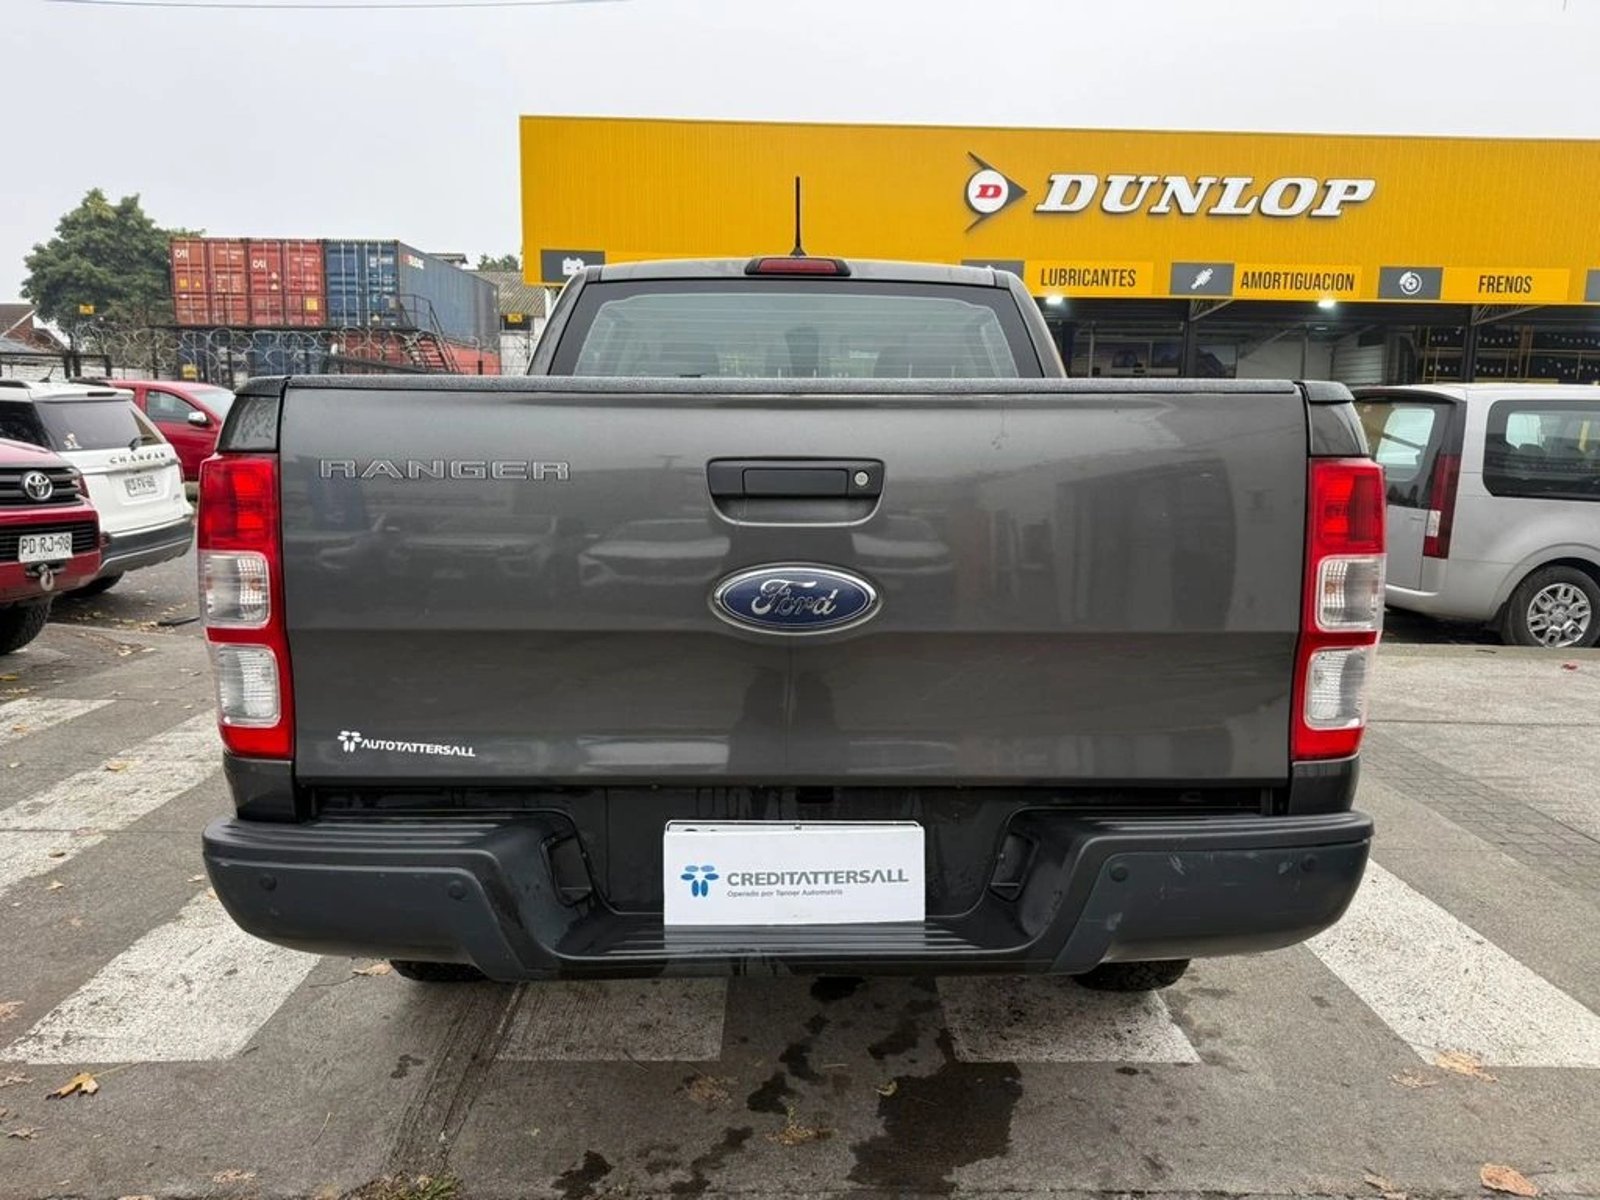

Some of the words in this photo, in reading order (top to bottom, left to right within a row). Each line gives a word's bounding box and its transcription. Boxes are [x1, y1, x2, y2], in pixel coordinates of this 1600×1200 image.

[974, 183, 1002, 199] D
[1034, 173, 1376, 218] DUNLOP
[1040, 268, 1137, 288] LUBRICANTES
[1240, 270, 1355, 292] AMORTIGUACION
[1477, 275, 1533, 294] FRENOS
[319, 459, 571, 481] RANGER
[751, 578, 839, 616] Ford
[360, 738, 476, 757] AUTOTATTERSALL
[727, 869, 909, 887] CREDITATTERSALL
